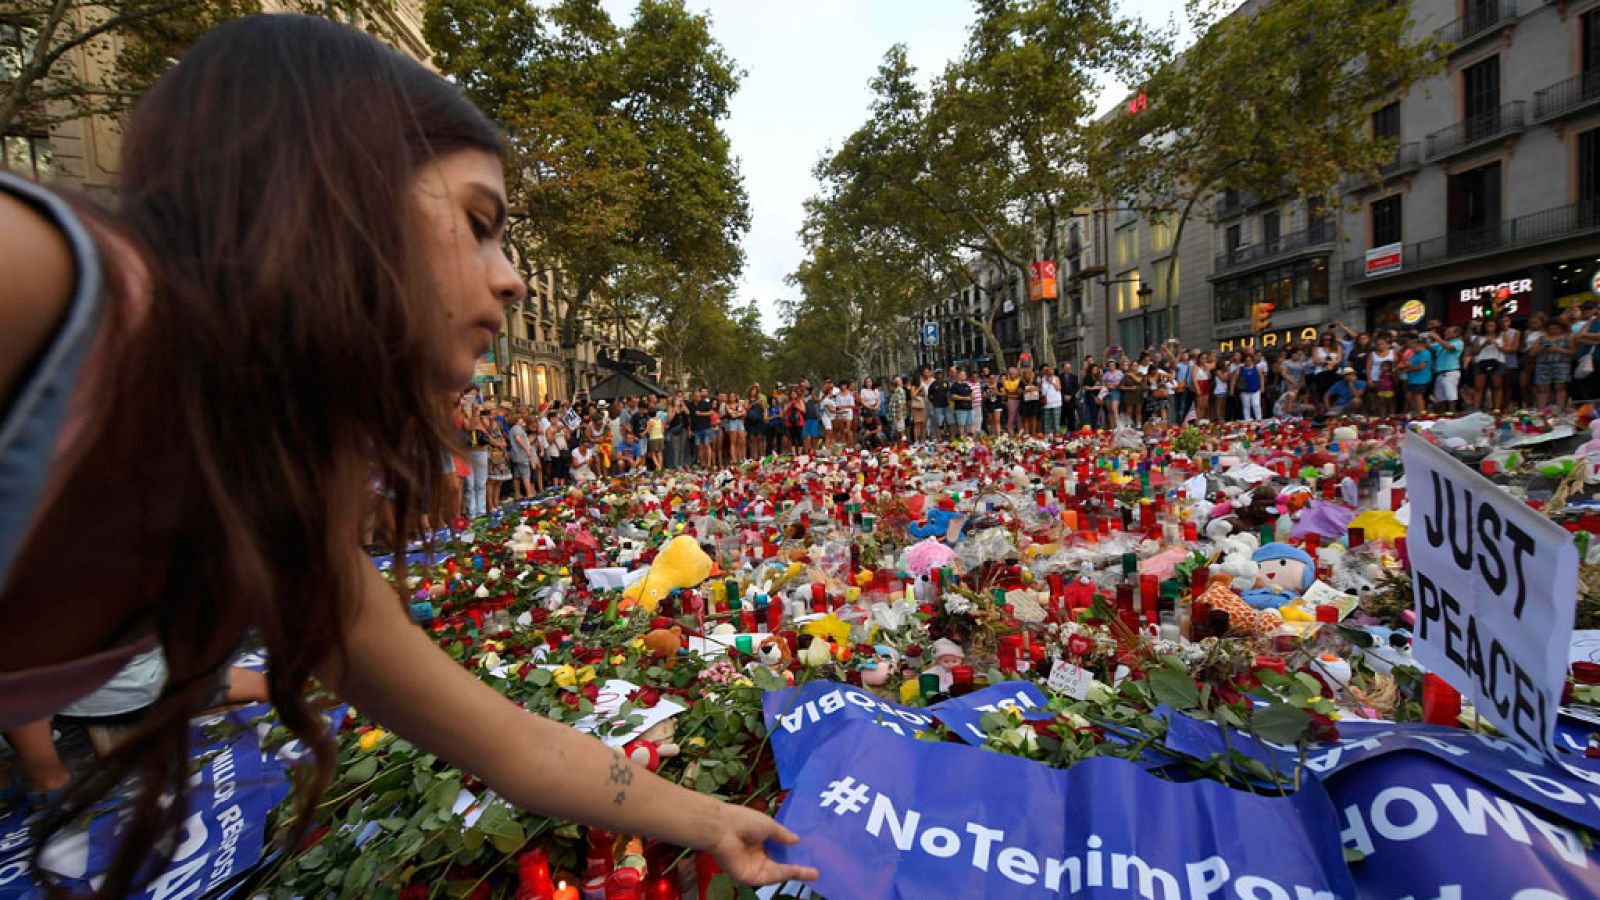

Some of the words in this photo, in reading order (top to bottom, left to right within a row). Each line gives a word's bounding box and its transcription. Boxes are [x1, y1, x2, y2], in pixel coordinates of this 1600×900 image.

[1220, 327, 1317, 353] NURIA
[1471, 300, 1518, 318] KG
[1424, 470, 1535, 619] JUST
[1416, 570, 1551, 756] PEACE!
